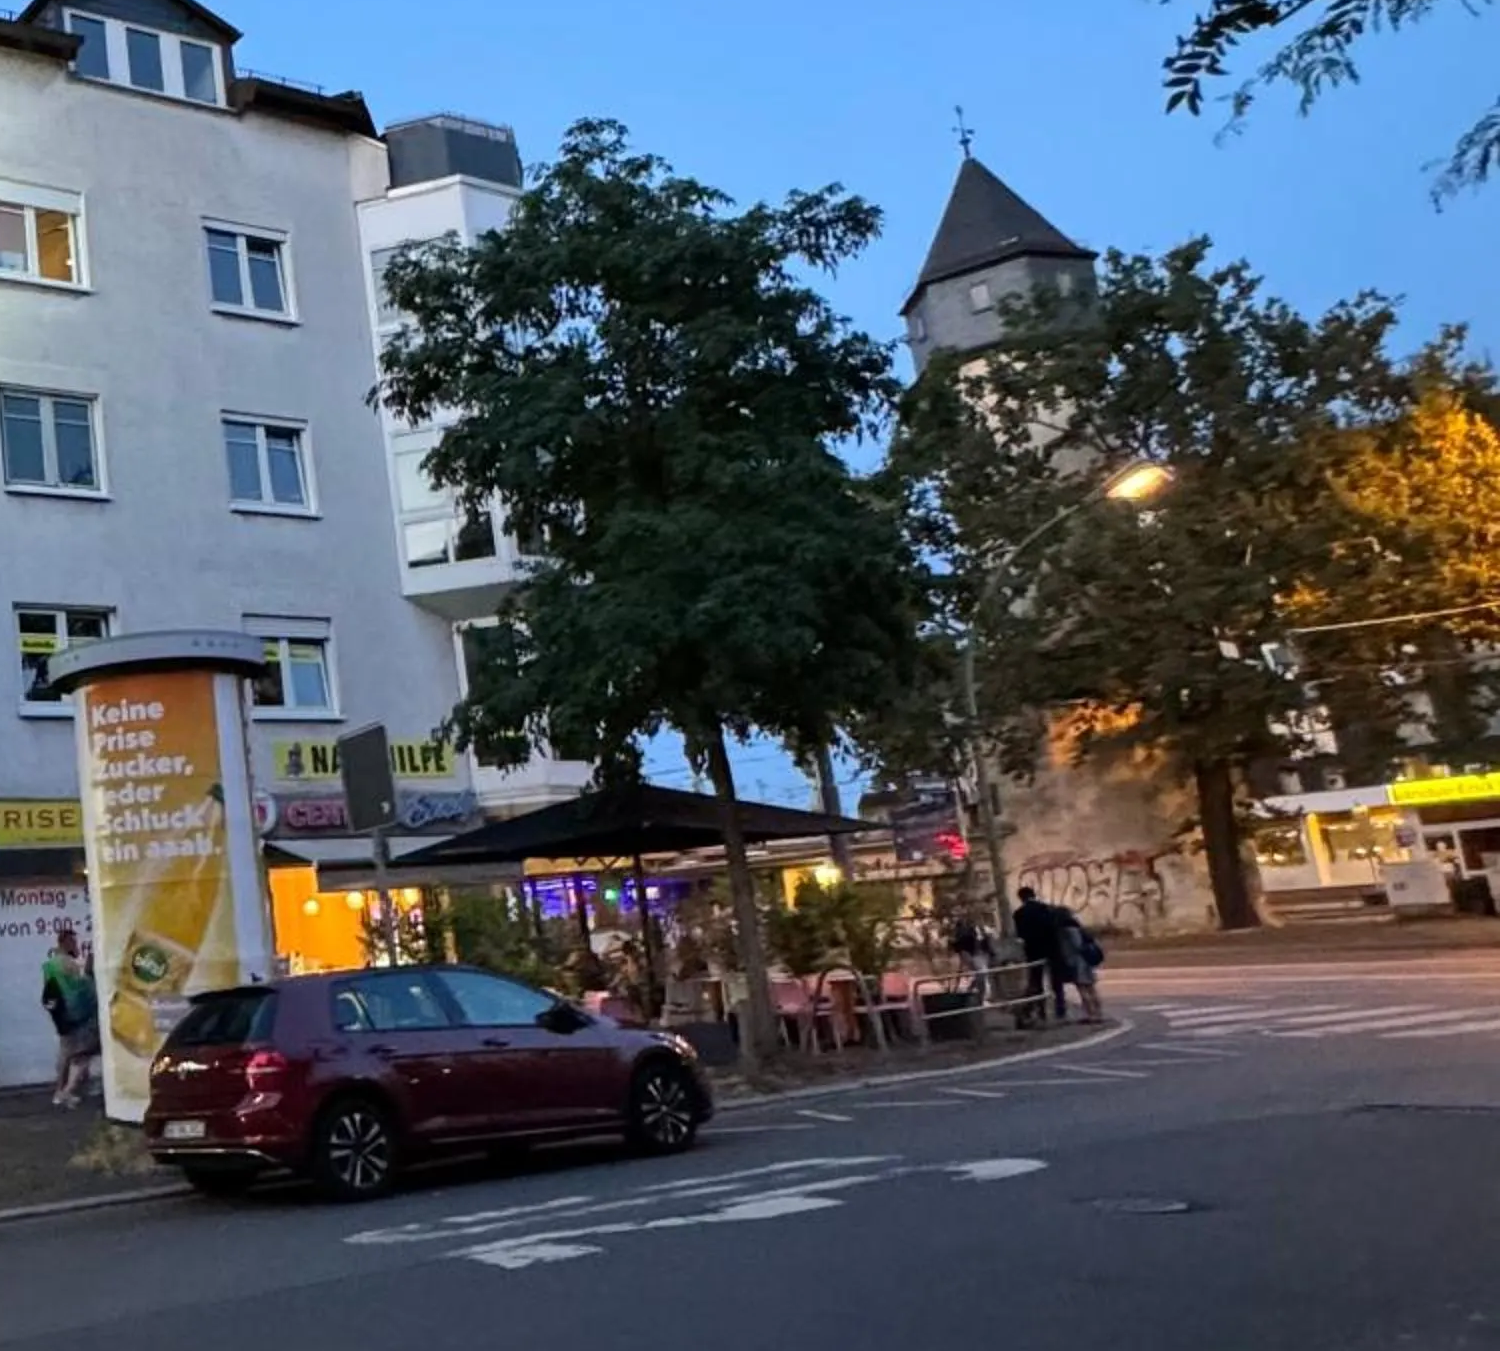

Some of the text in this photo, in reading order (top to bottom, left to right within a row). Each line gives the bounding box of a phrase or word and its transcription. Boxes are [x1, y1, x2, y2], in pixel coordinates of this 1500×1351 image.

[92, 700, 164, 727] Keine
[93, 728, 156, 754] Prise
[95, 753, 194, 781] Zucker,
[97, 803, 204, 837] Schluck
[103, 838, 139, 863] ein
[0, 888, 67, 909] Montag
